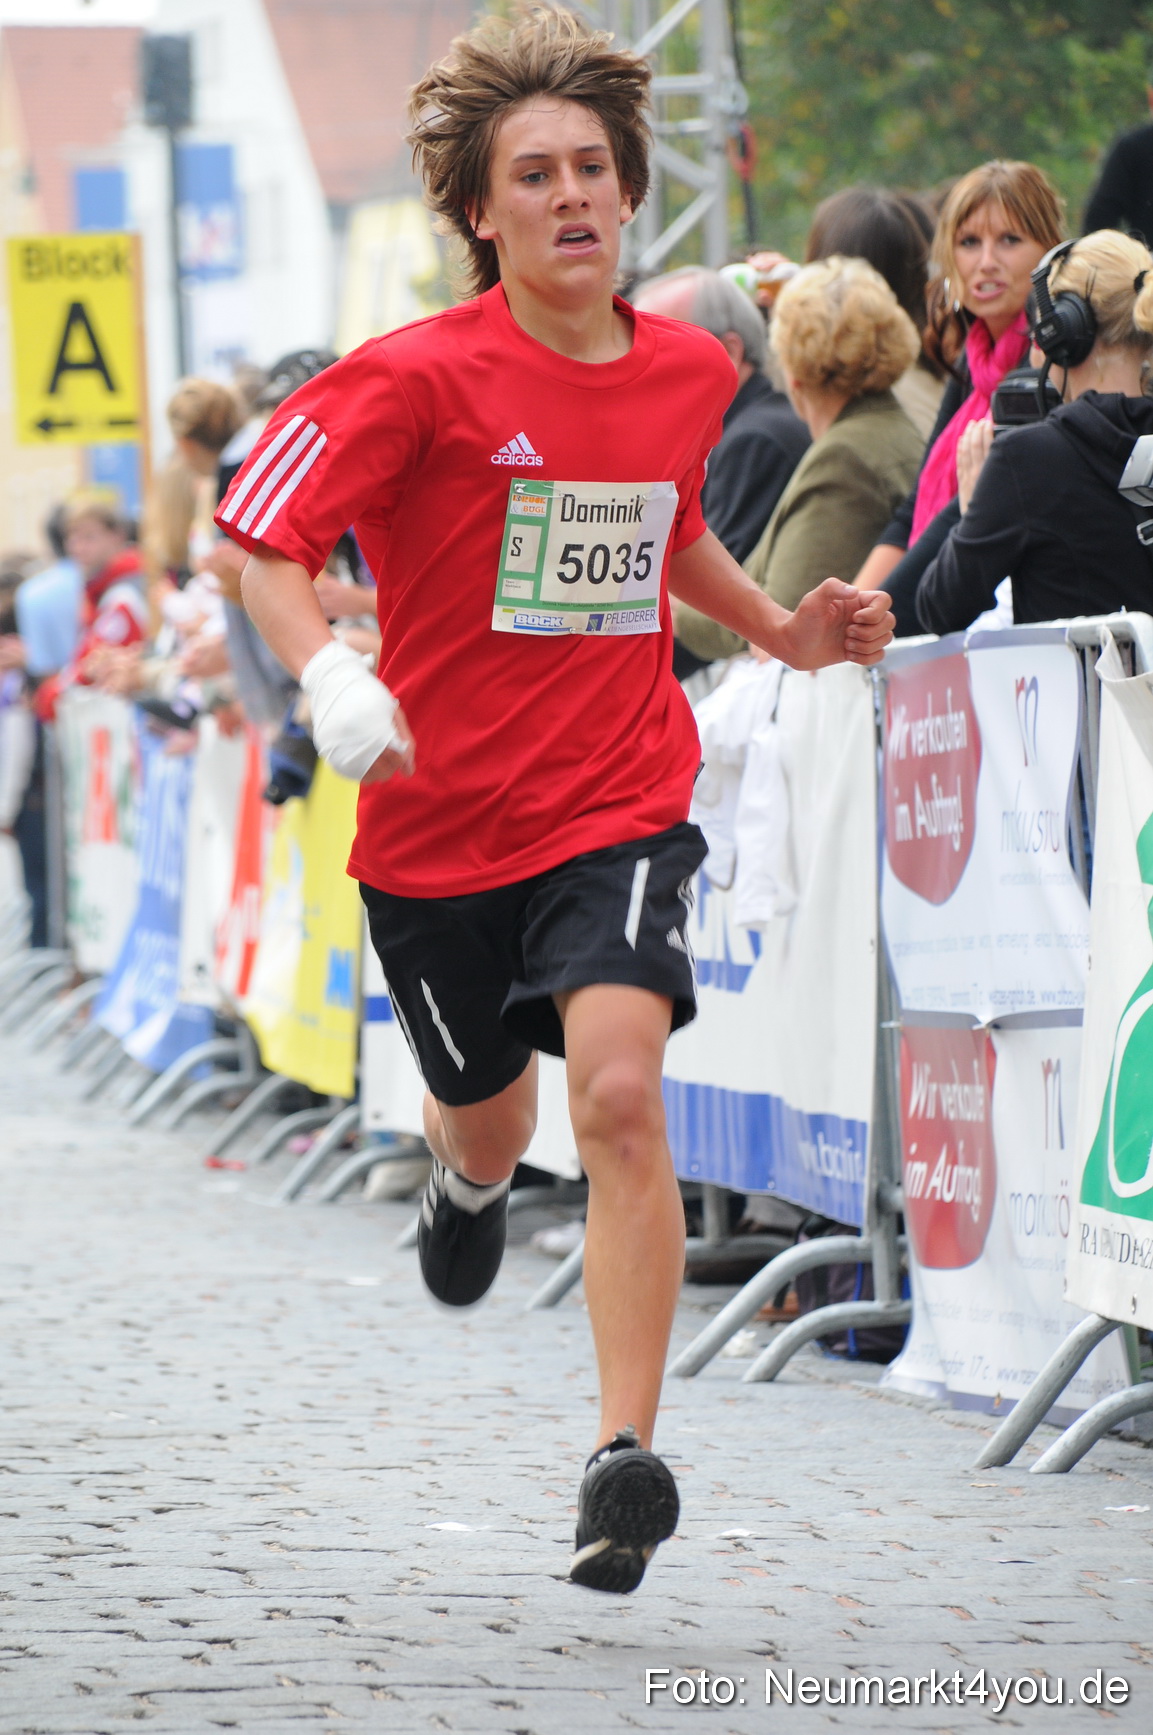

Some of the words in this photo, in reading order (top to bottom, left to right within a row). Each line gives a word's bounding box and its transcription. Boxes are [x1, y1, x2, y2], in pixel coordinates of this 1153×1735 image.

[21, 243, 128, 281] Block
[48, 300, 116, 395] A
[491, 452, 543, 466] adidas
[560, 493, 644, 523] Dominik
[510, 537, 523, 557] S
[556, 541, 655, 585] 5035
[514, 614, 564, 627] BOCK
[604, 609, 656, 626] PFLEIDERER
[911, 686, 967, 758] verkaufen
[894, 785, 914, 841] im
[907, 1062, 938, 1121] Wir
[904, 1143, 928, 1199] im
